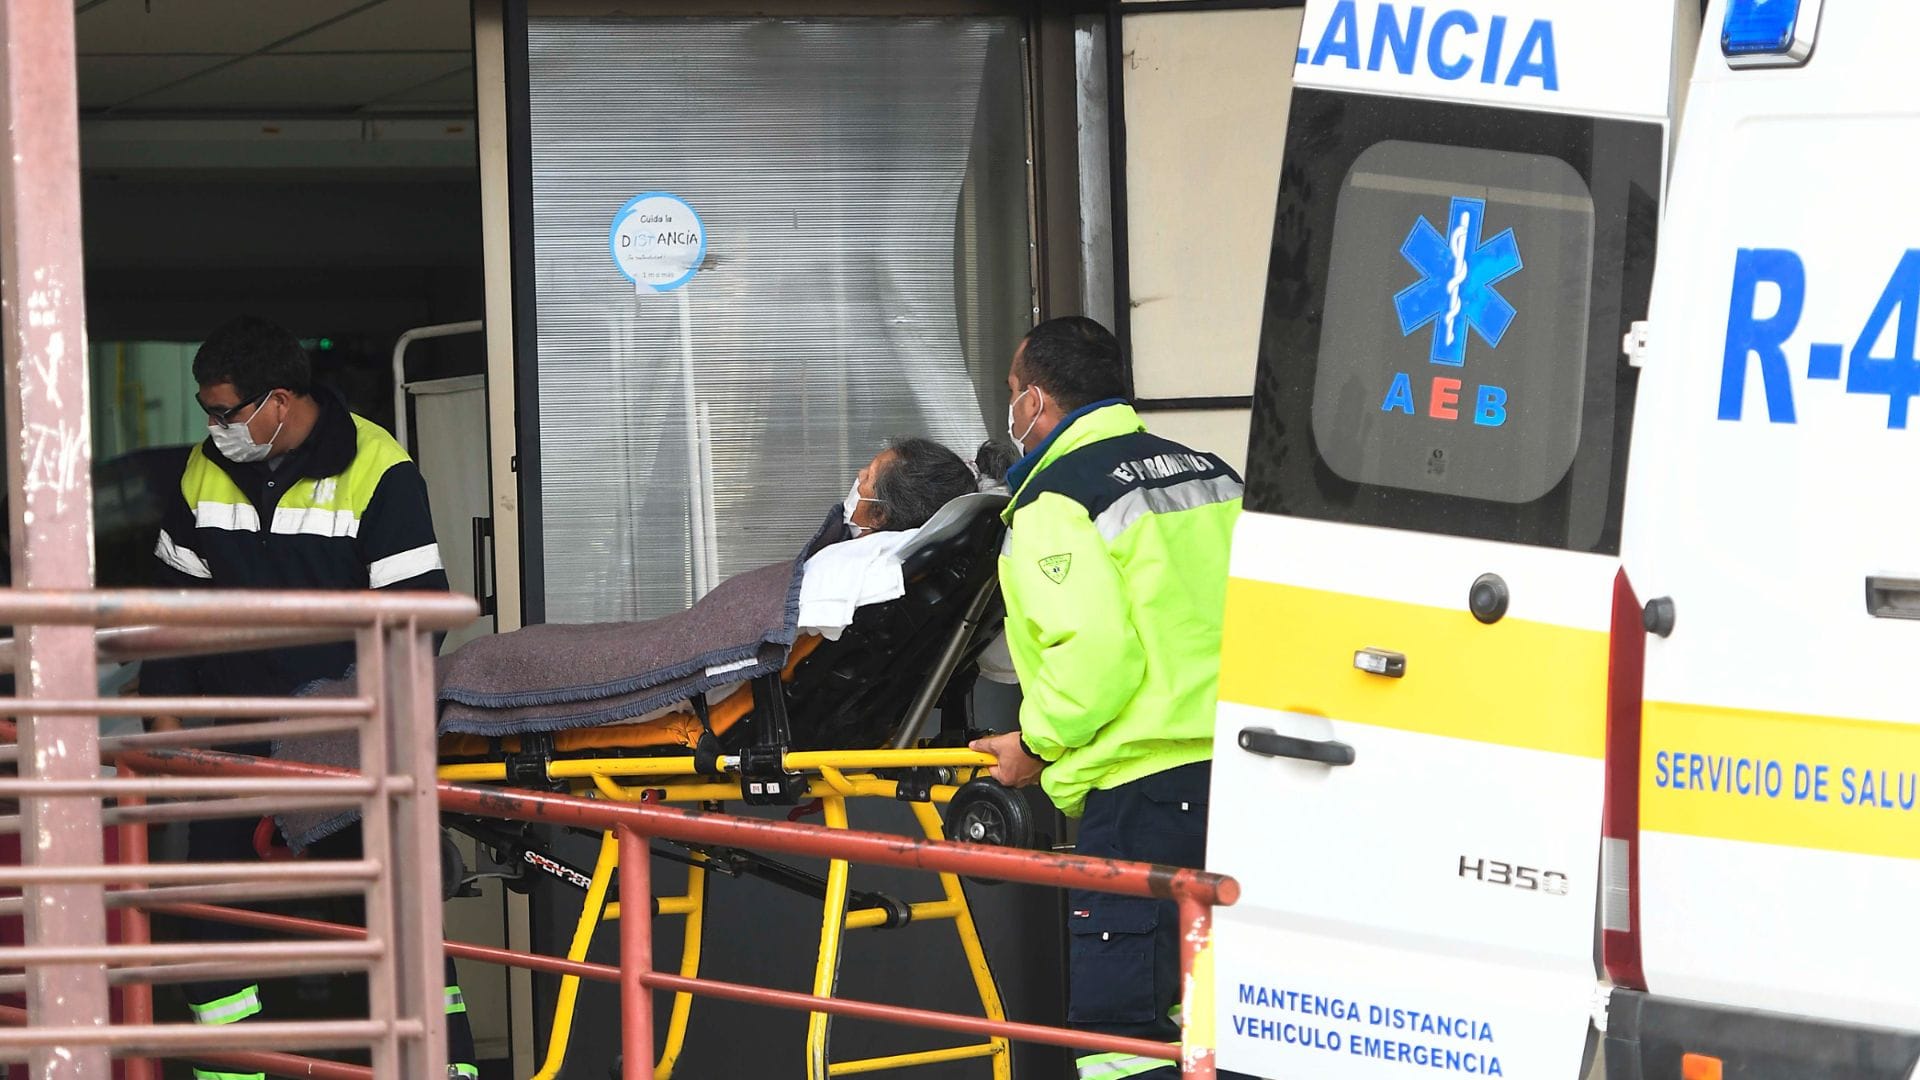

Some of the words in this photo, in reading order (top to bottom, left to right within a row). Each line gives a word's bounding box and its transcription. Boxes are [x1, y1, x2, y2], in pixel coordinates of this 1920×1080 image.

[1655, 750, 1783, 799] SERVICIO
[1793, 762, 1830, 803] DE
[1840, 767, 1916, 811] SALU
[523, 850, 592, 891] SPENCER
[1458, 855, 1568, 896] H350
[1239, 983, 1361, 1022] MANTENGA
[1369, 1005, 1494, 1043] DISTANCIA
[1233, 1015, 1341, 1052] VEHICULO
[1350, 1034, 1504, 1077] EMERGENCIA
